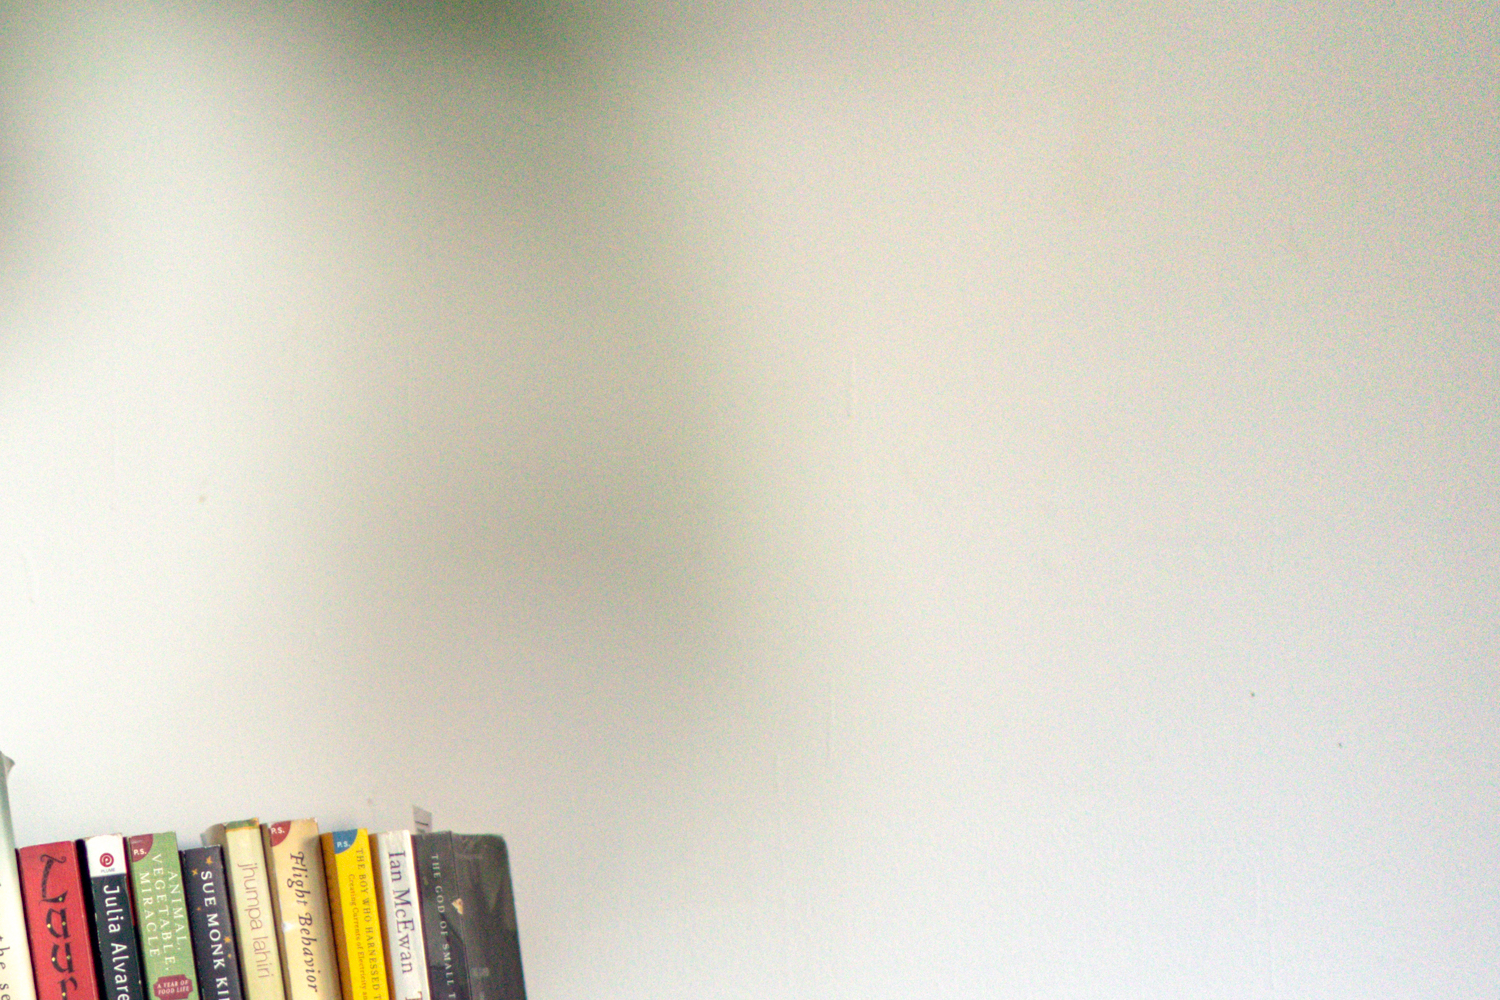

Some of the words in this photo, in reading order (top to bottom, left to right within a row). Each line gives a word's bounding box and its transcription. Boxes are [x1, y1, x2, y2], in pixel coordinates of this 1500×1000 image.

[271, 826, 285, 835] P.S.
[133, 848, 147, 856] P.S.
[356, 848, 365, 870] THE
[388, 850, 406, 883] Ian
[431, 853, 441, 878] THE
[201, 870, 217, 907] SUE
[286, 851, 311, 906] Flight
[348, 873, 358, 907] Creating
[358, 874, 368, 894] BOY
[103, 885, 124, 933] Julia
[140, 872, 160, 958] MIRACLE
[362, 897, 372, 922] WHO
[435, 885, 445, 913] GOD
[237, 862, 263, 931] jhumpa
[252, 936, 274, 979] lahiri
[352, 907, 361, 941] Currents
[393, 888, 415, 974] McEwan
[440, 921, 449, 936] OF
[207, 913, 225, 969] MONK
[298, 912, 321, 993] Behavior
[356, 942, 363, 950] of
[365, 926, 380, 991] HARNESSED
[442, 943, 454, 986] SMALL
